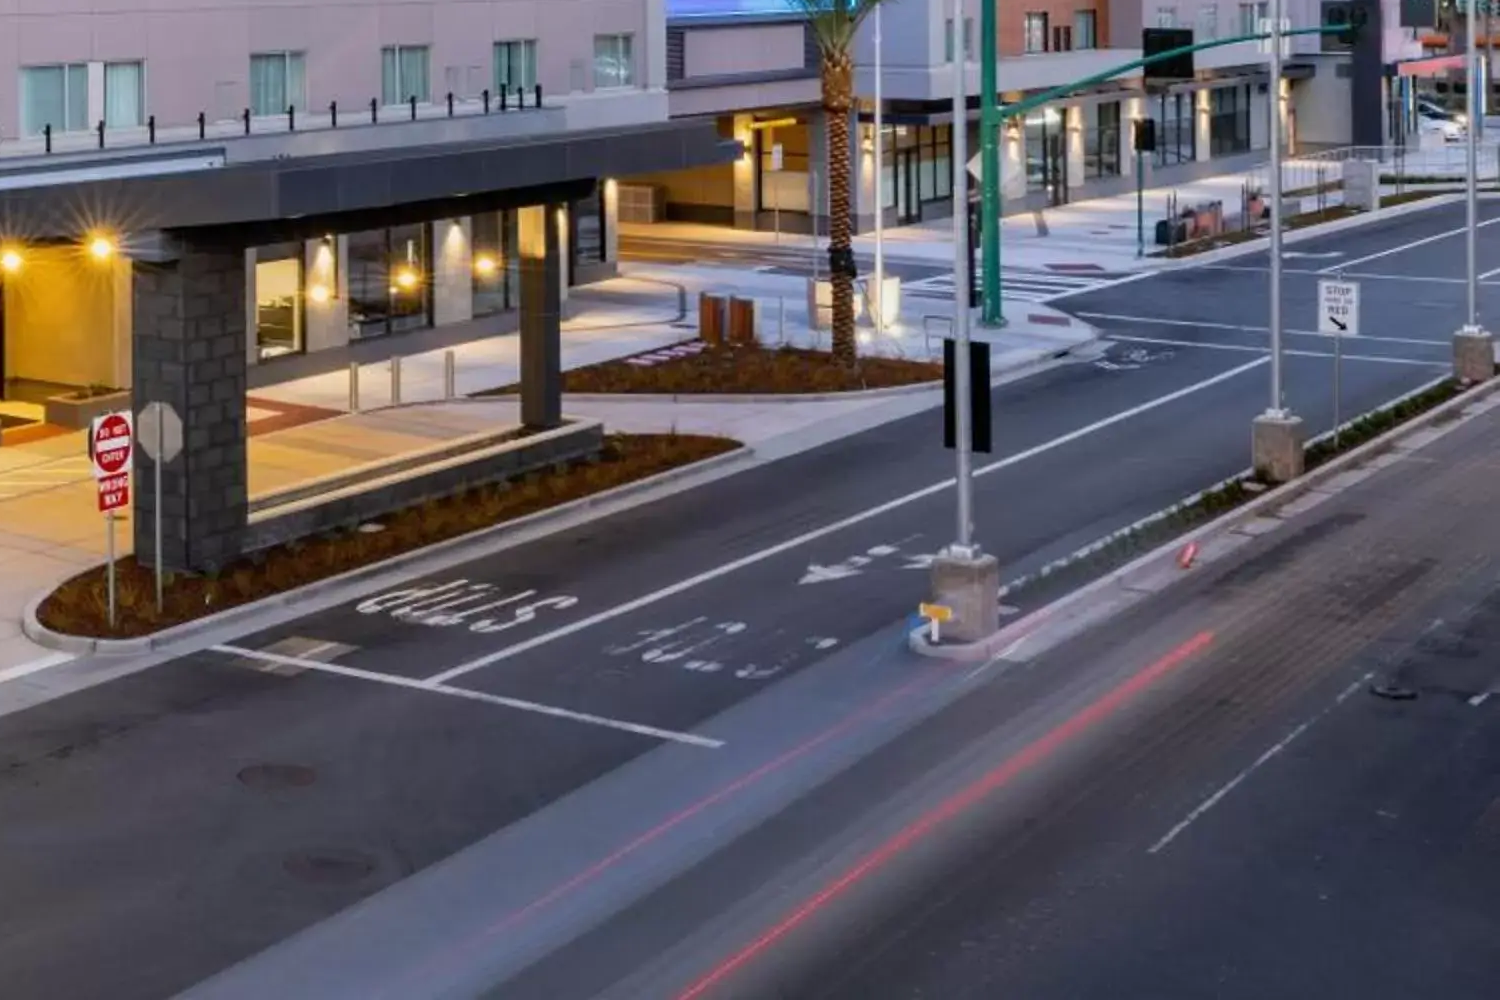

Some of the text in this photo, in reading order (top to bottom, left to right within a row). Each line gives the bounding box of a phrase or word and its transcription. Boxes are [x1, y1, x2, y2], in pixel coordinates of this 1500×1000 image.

[1325, 285, 1353, 296] STOP
[99, 423, 128, 439] DO NOT
[101, 449, 125, 464] ENTER
[99, 475, 129, 492] WRONG
[103, 492, 123, 505] WAY
[356, 579, 579, 634] STOP
